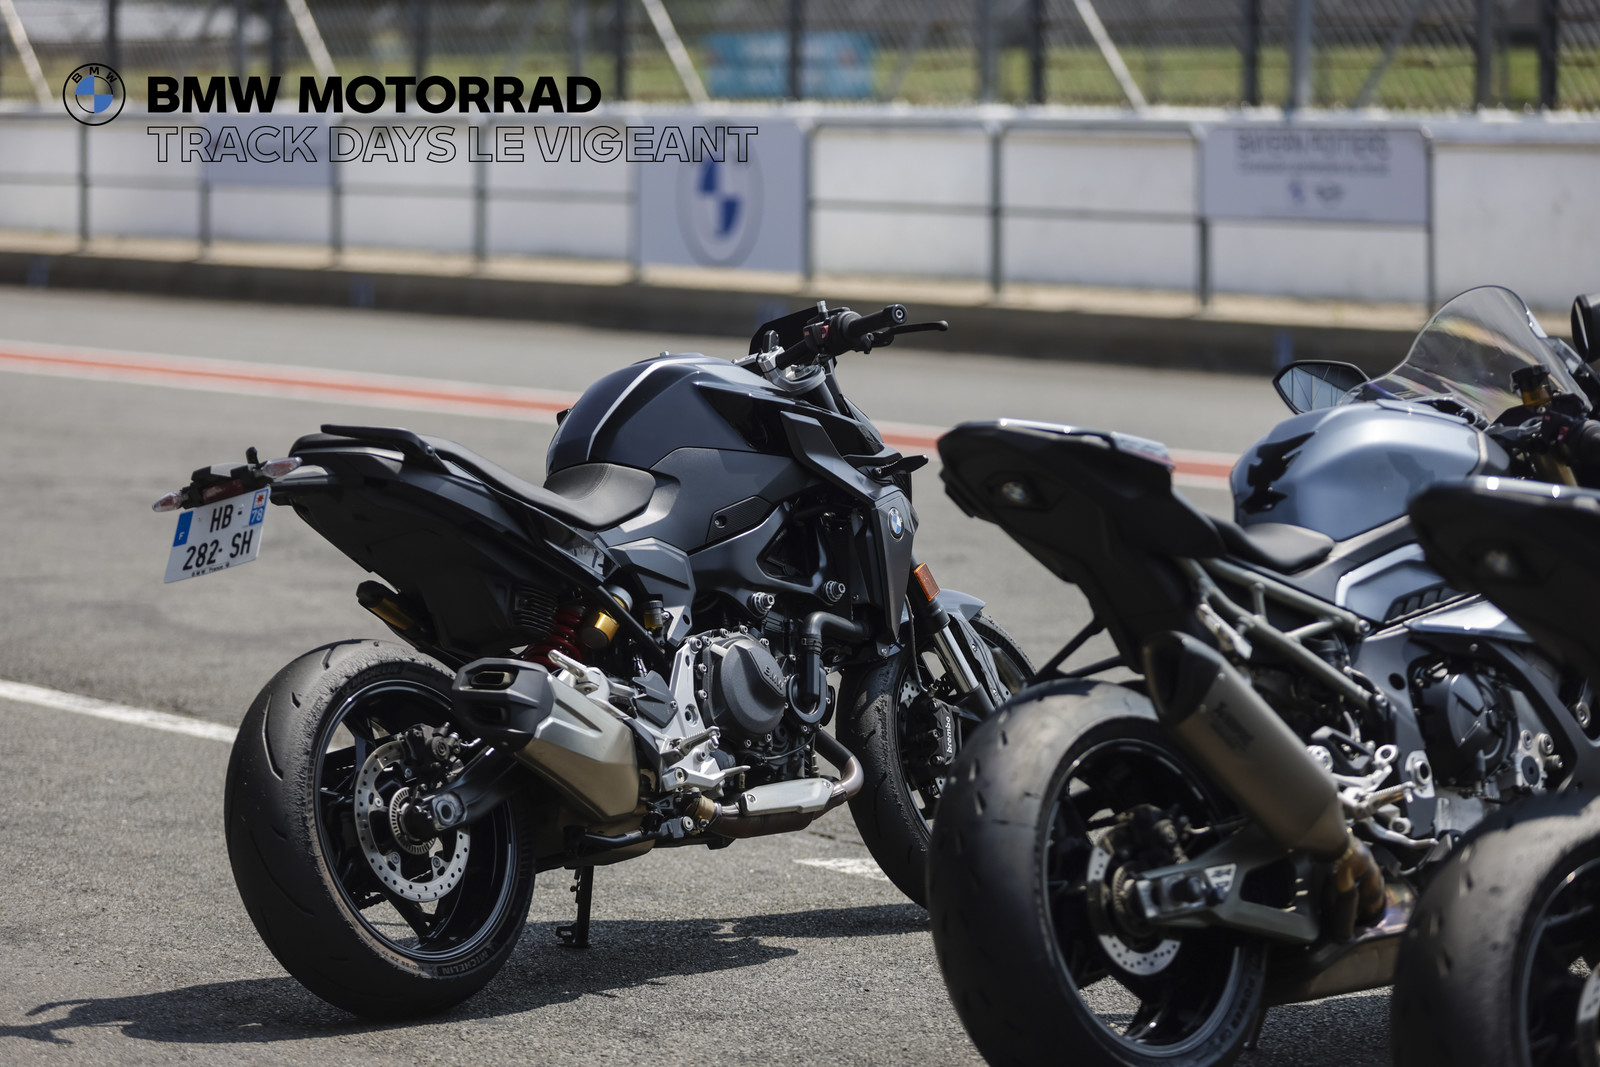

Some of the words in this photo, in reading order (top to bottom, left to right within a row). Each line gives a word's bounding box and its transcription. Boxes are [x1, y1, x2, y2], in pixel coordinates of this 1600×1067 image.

[250, 507, 264, 524] 78
[178, 531, 185, 541] F
[229, 529, 254, 559] SH
[763, 665, 786, 691] BMW
[945, 716, 953, 754] brembo
[441, 950, 491, 976] MICHELIN
